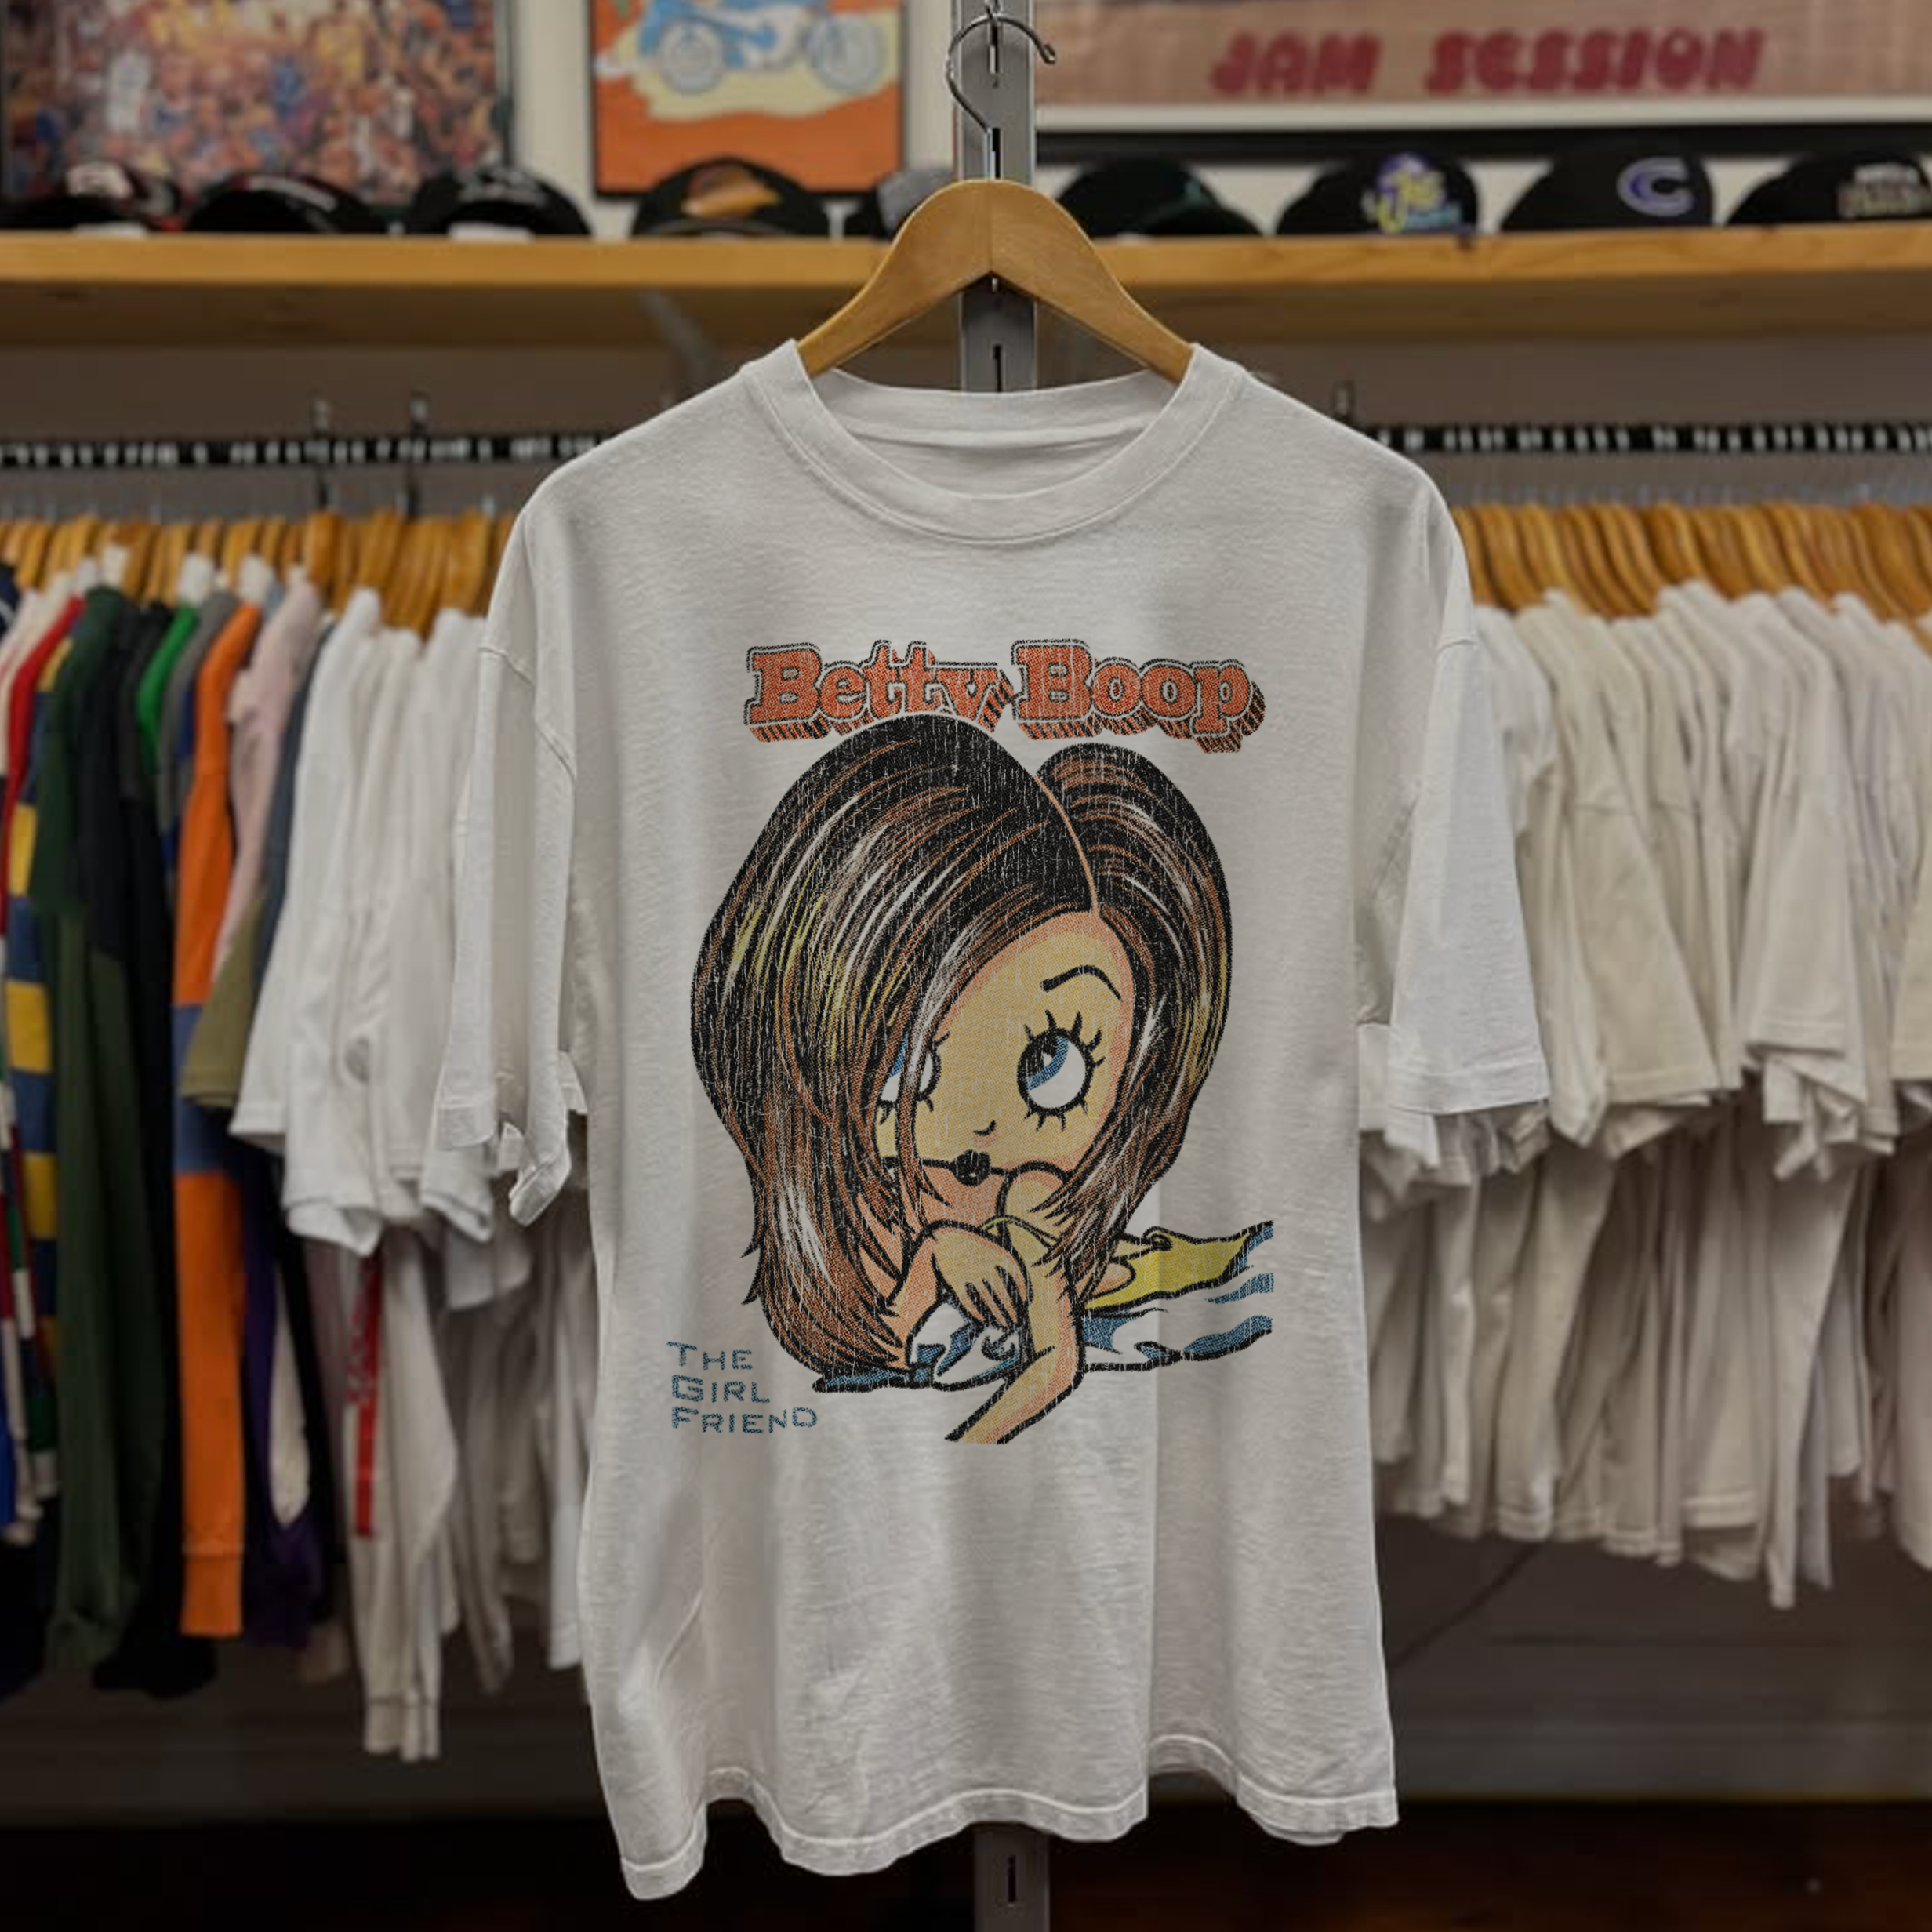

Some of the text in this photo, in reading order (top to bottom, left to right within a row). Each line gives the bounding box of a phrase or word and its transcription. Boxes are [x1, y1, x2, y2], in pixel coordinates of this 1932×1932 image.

[1211, 27, 1766, 97] JAM SESSION
[1617, 157, 1694, 217] C
[744, 638, 1266, 754] Betty Boop
[666, 1341, 754, 1371] THE
[671, 1374, 771, 1404] GIRL
[671, 1406, 818, 1434] FRIEND
